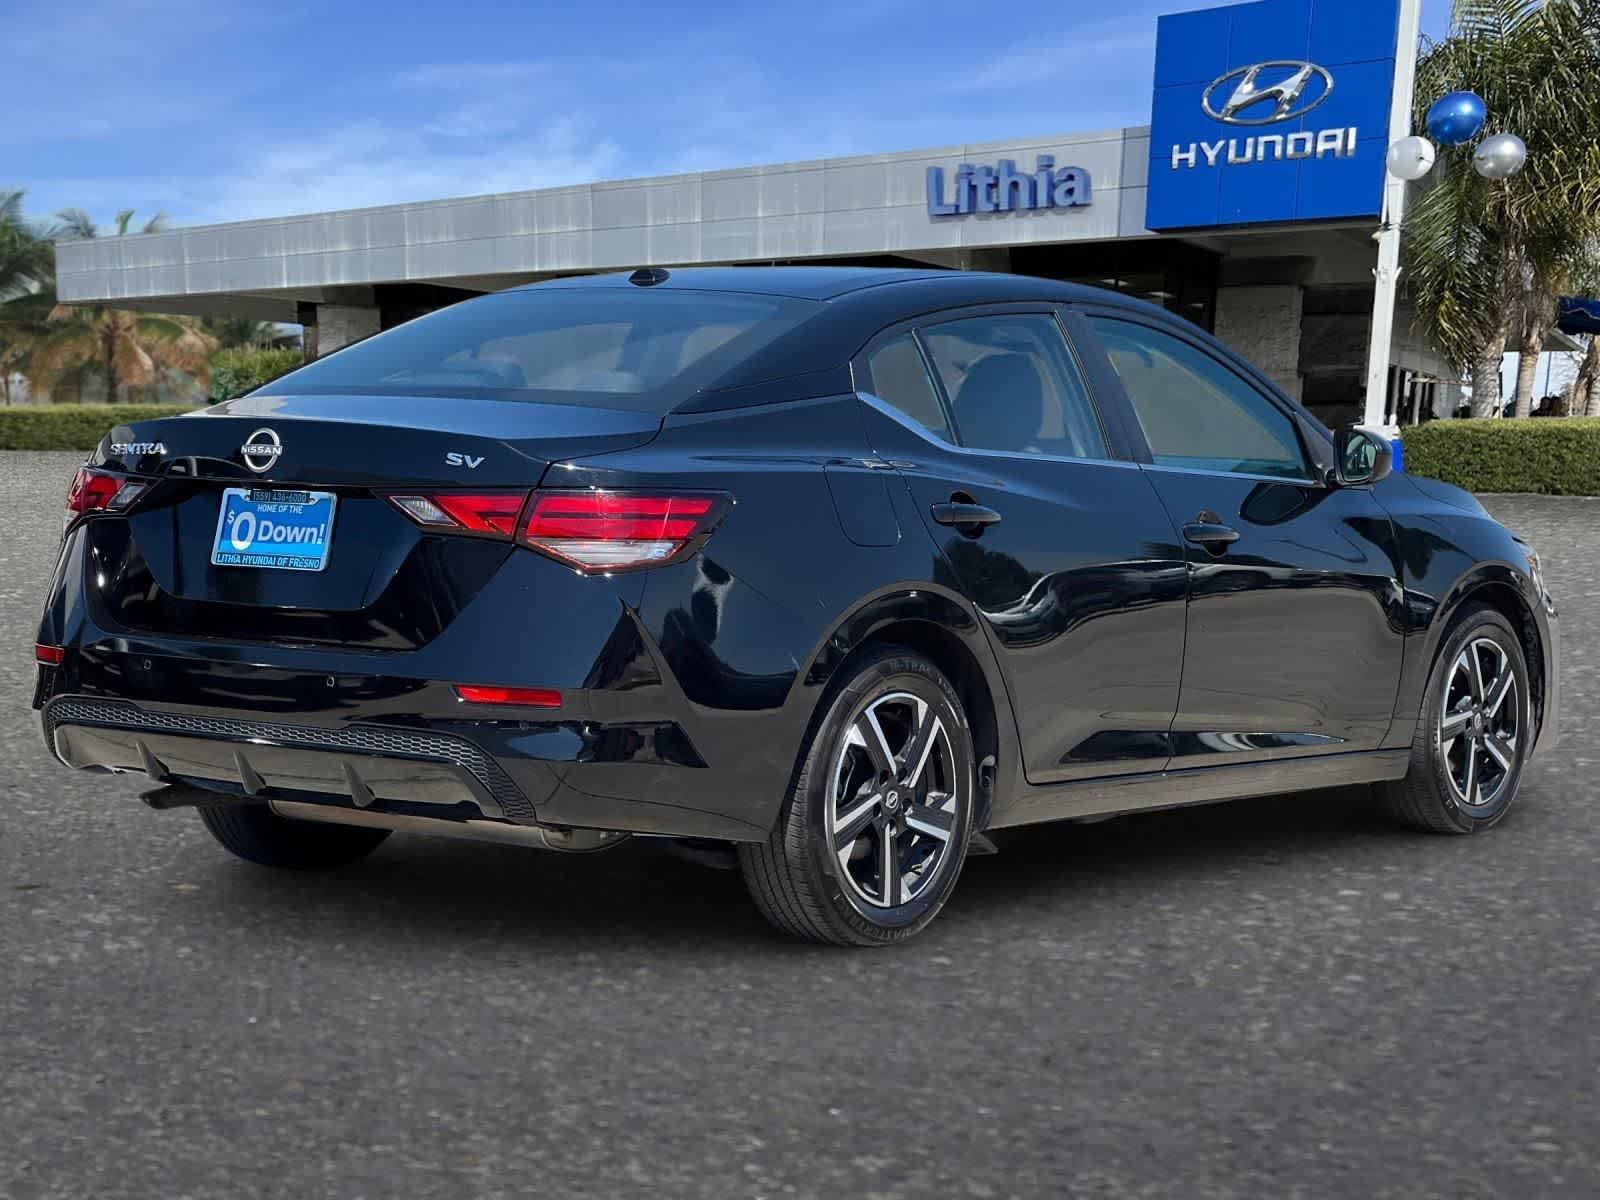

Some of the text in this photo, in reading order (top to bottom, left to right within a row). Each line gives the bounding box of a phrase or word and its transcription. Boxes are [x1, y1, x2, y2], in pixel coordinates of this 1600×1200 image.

[1171, 127, 1357, 169] HYUNDAI
[926, 154, 1093, 217] Lithia
[110, 442, 168, 455] SENTRA
[241, 445, 283, 455] NISSAN
[445, 452, 486, 469] SV
[257, 503, 304, 515] HOME OF THE
[258, 520, 326, 545] Down!
[216, 552, 320, 569] LITHIA HYUNDAI OF FRESNO
